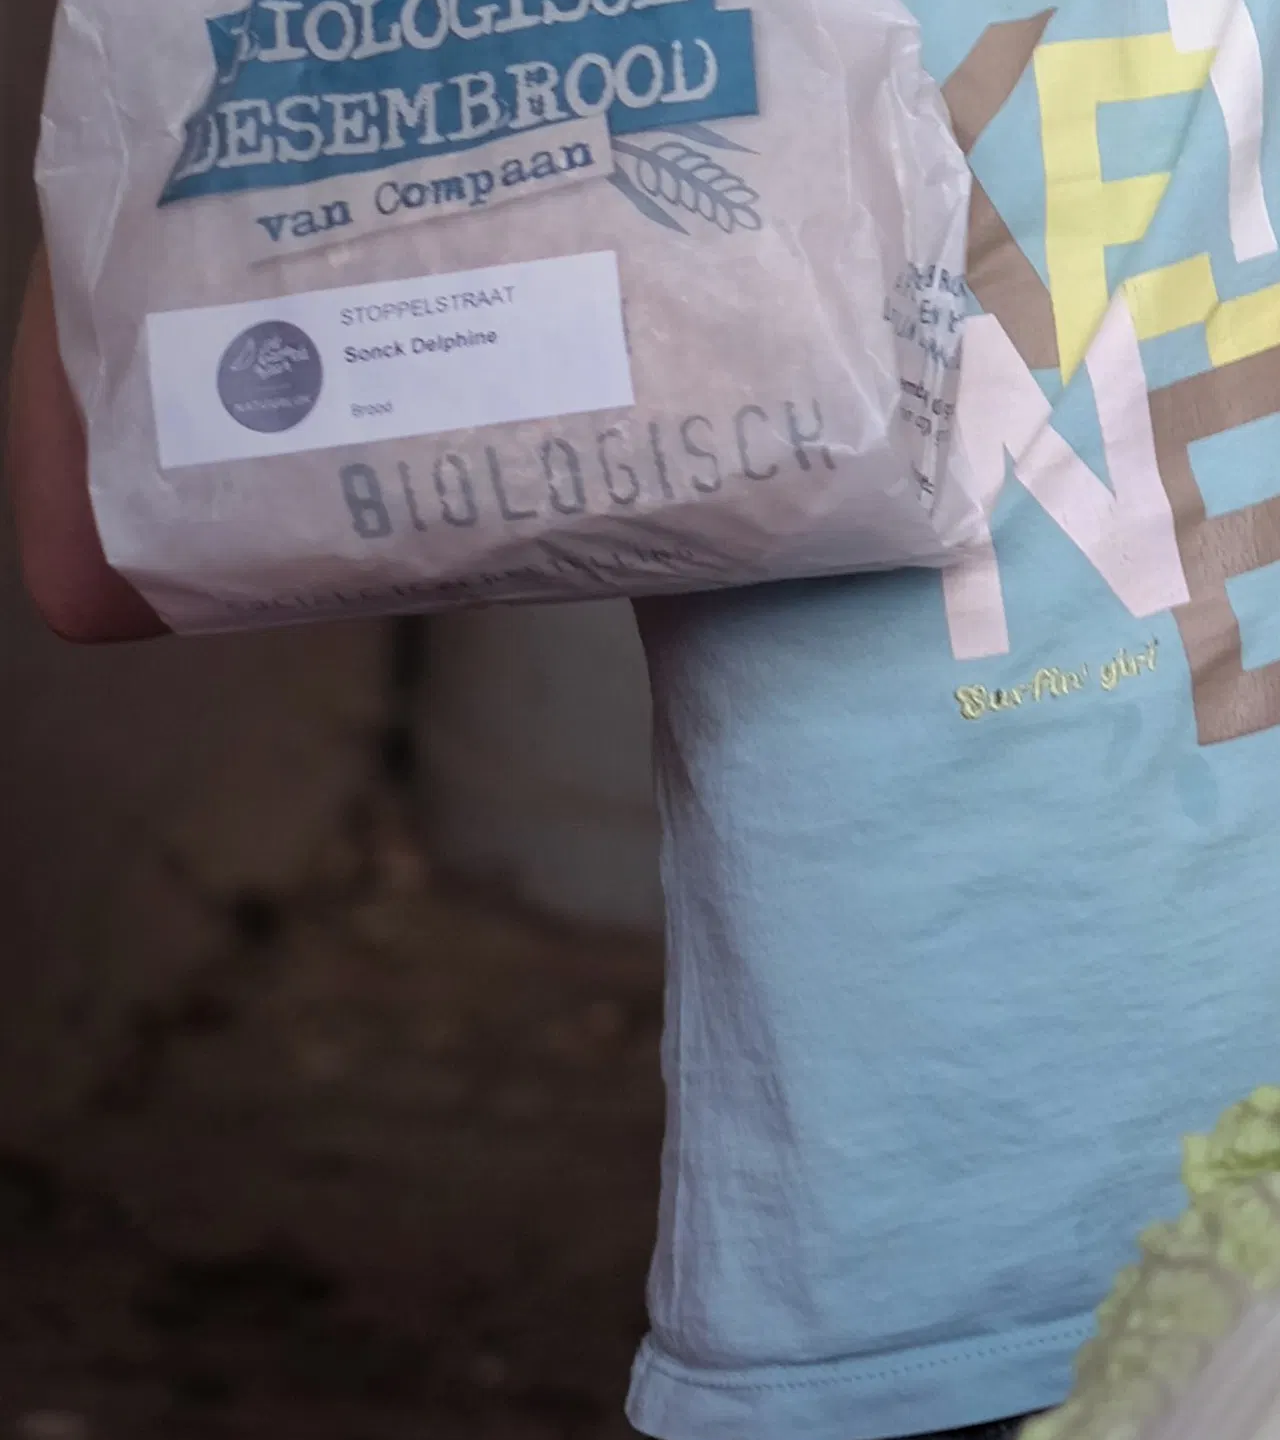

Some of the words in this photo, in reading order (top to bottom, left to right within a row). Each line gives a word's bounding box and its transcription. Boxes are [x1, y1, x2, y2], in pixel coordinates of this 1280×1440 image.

[254, 198, 353, 243] van
[374, 138, 597, 216] Compaan
[340, 285, 516, 326] STOPPELSTRAAT
[343, 339, 405, 364] Sonck
[411, 327, 498, 357] Delphine
[350, 399, 394, 419] Brood
[338, 399, 837, 539] BIOLOGISCH
